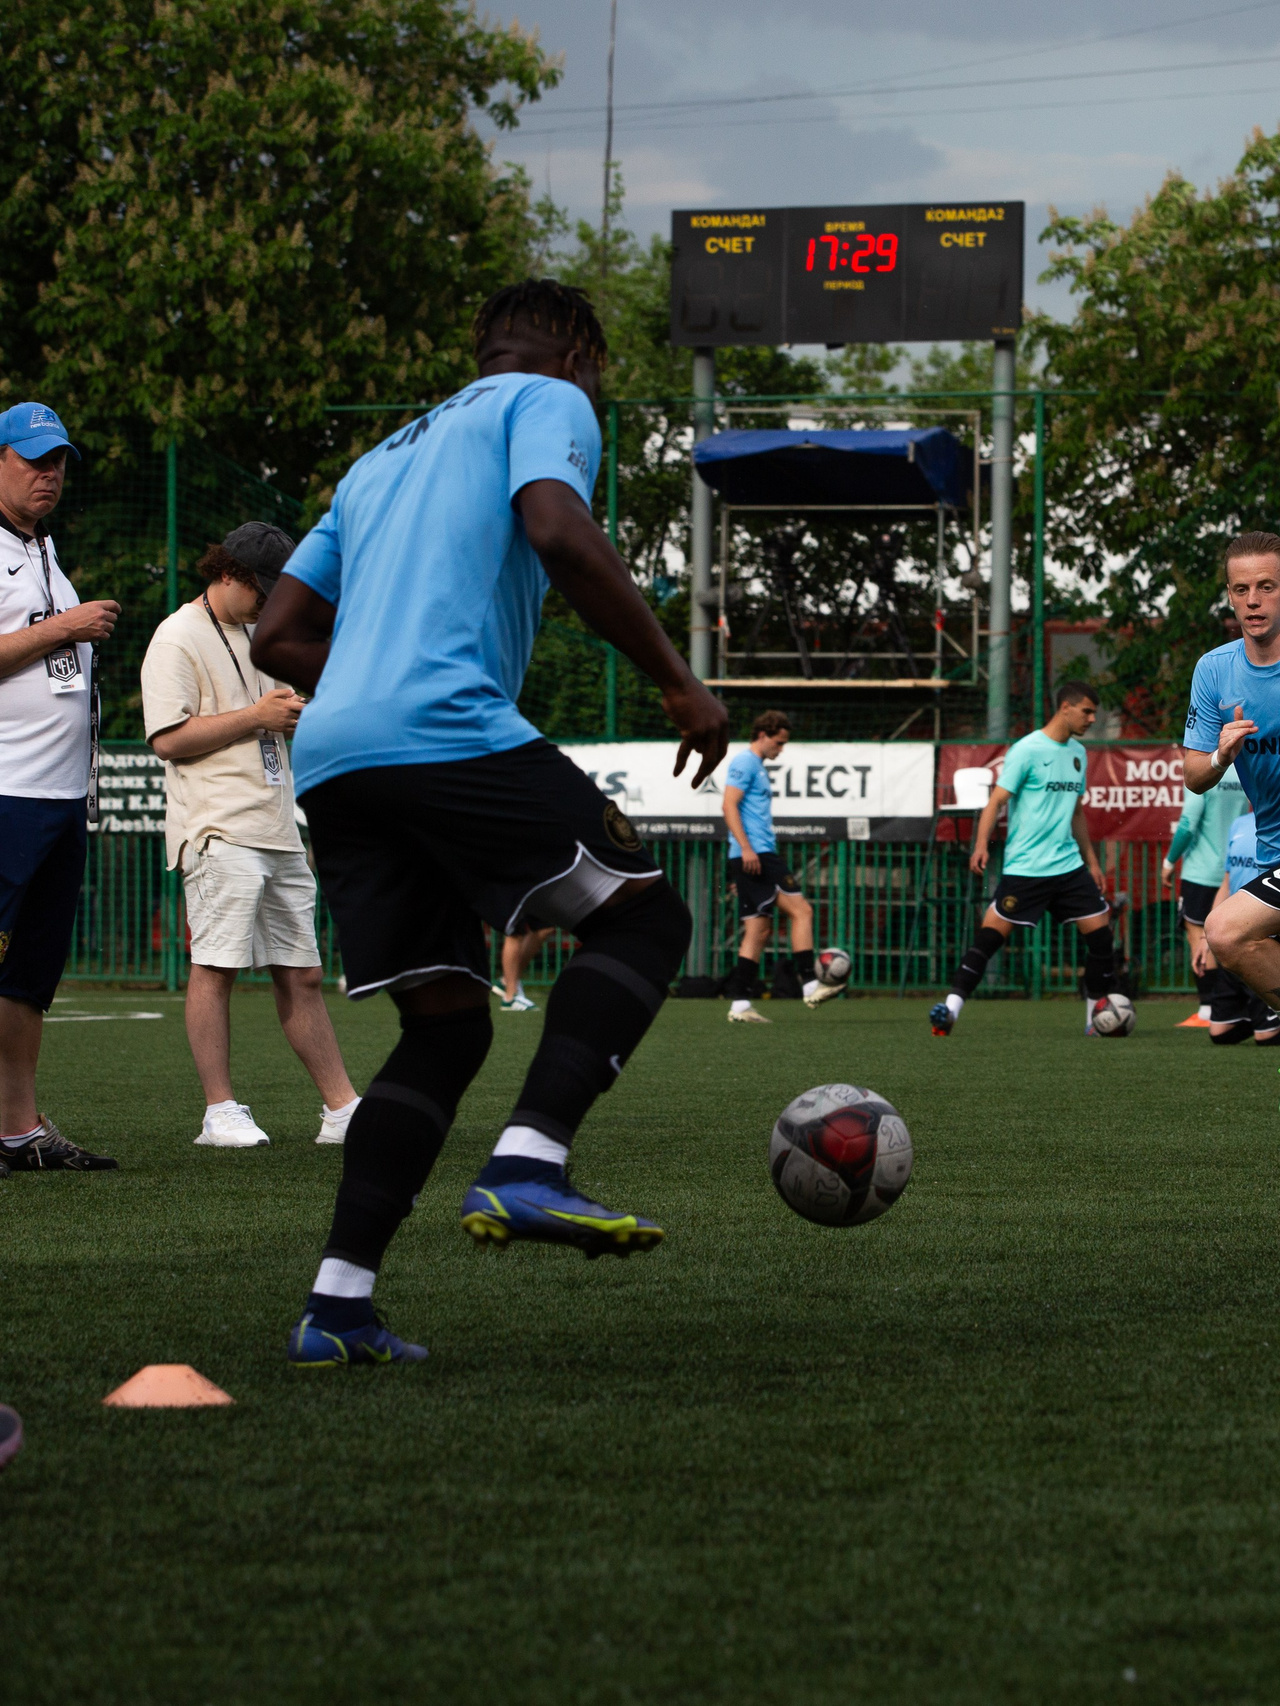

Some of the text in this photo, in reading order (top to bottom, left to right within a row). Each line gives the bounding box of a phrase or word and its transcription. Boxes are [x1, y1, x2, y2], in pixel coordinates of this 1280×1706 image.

[690, 214, 766, 229] КОМАНДА1
[925, 207, 1005, 223] КОМАНДА2
[705, 236, 755, 254] СЧЕТ
[940, 231, 987, 248] СЧЕТ
[806, 233, 898, 273] 17:29
[1126, 760, 1184, 782] МОС
[765, 766, 872, 798] ELECT
